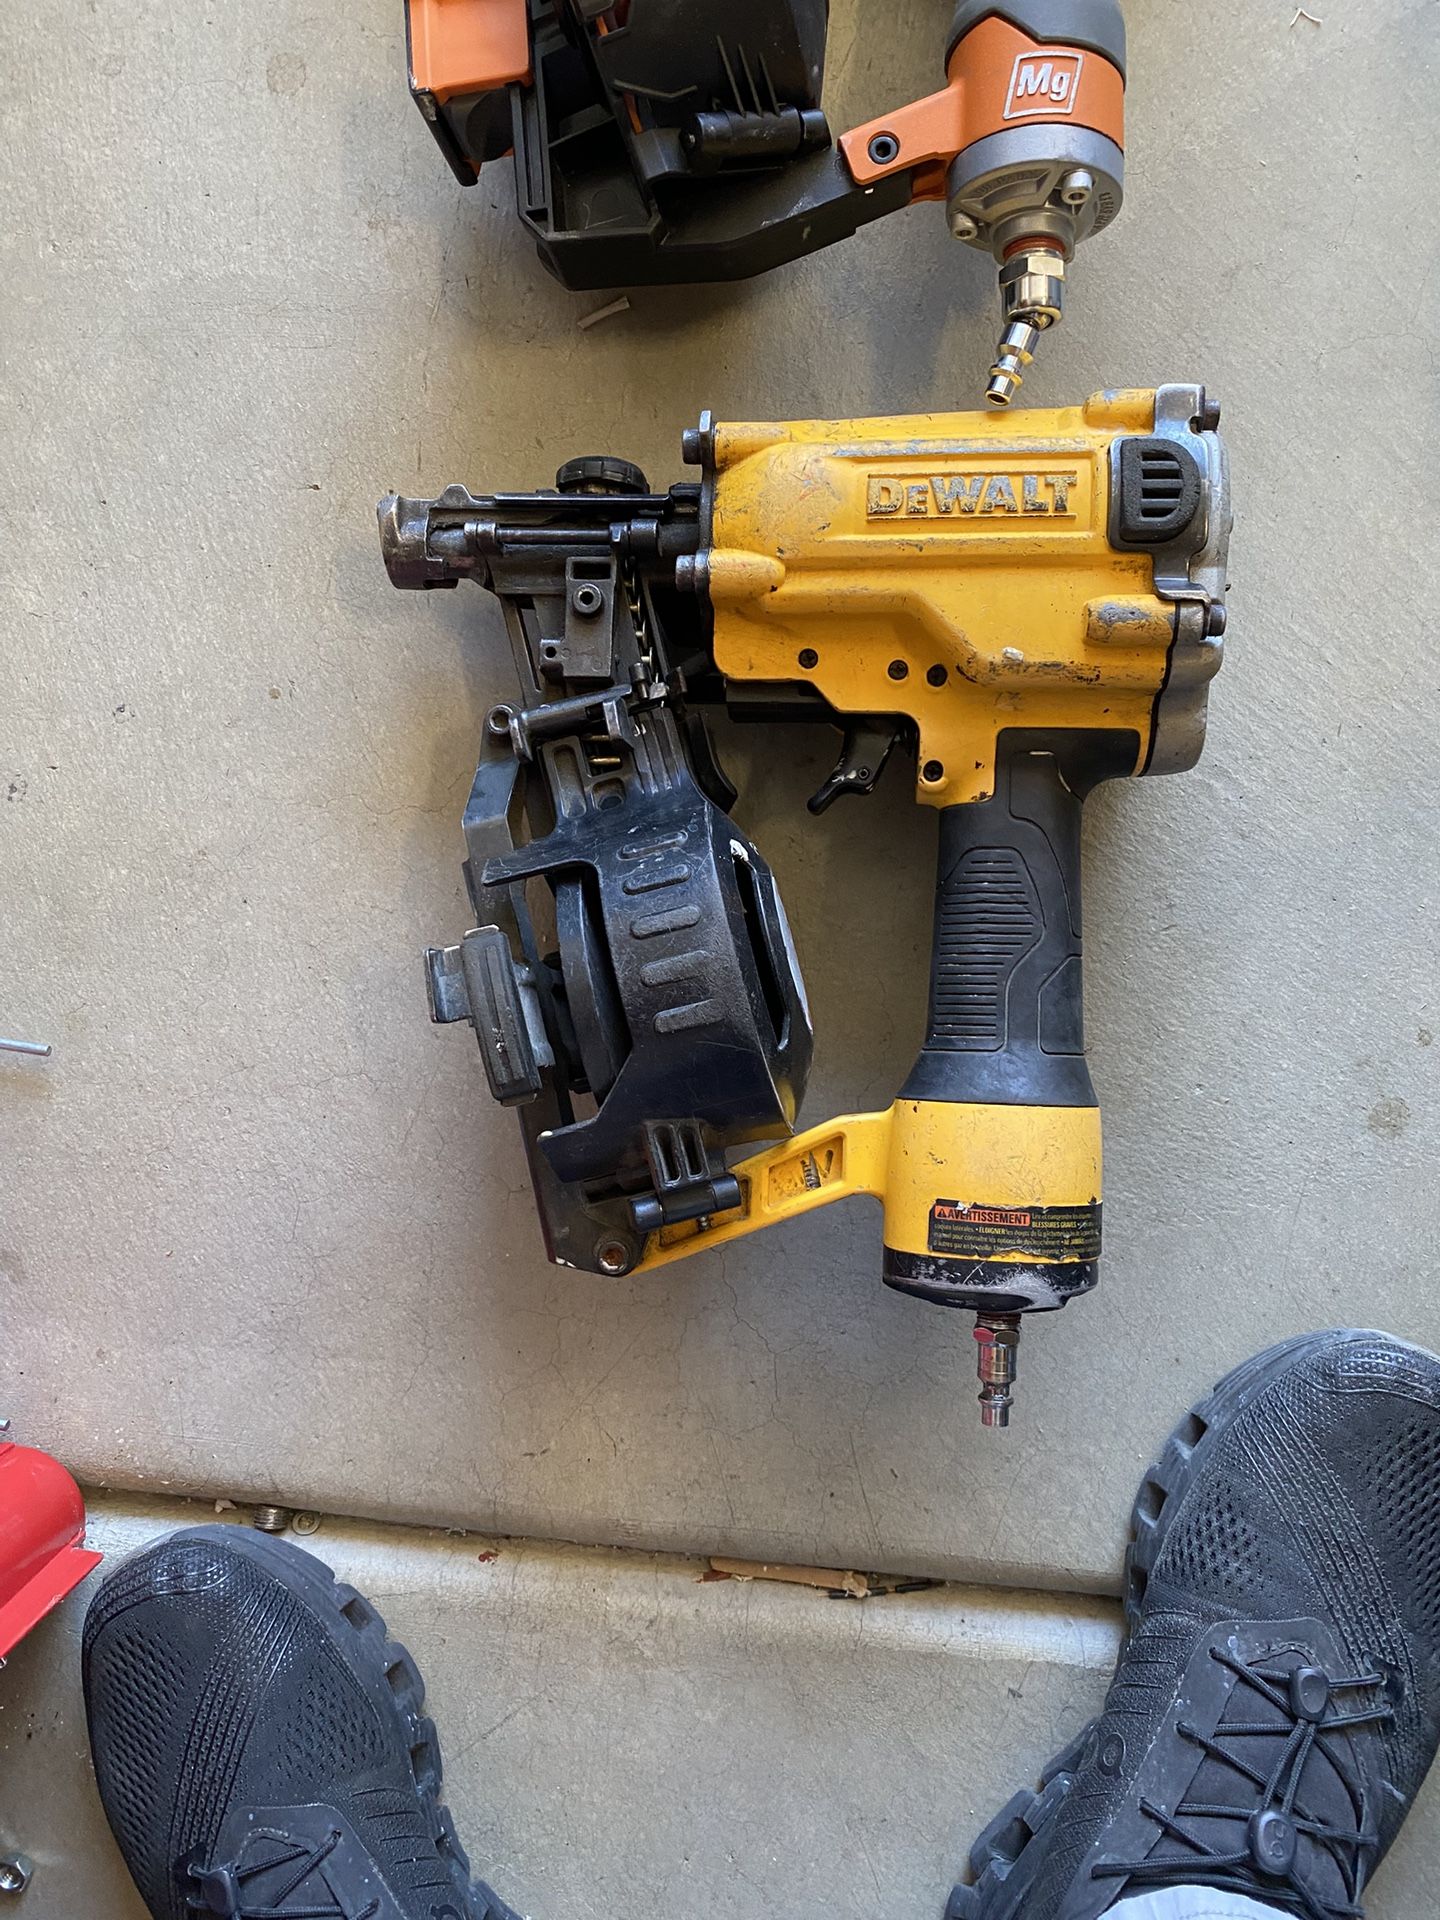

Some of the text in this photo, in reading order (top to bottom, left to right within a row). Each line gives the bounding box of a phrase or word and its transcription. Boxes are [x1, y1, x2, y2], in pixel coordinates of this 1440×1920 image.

[1016, 62, 1071, 102] Mg
[867, 475, 1078, 514] DEWALT
[948, 1207, 1028, 1225] AVERTISSEMENT
